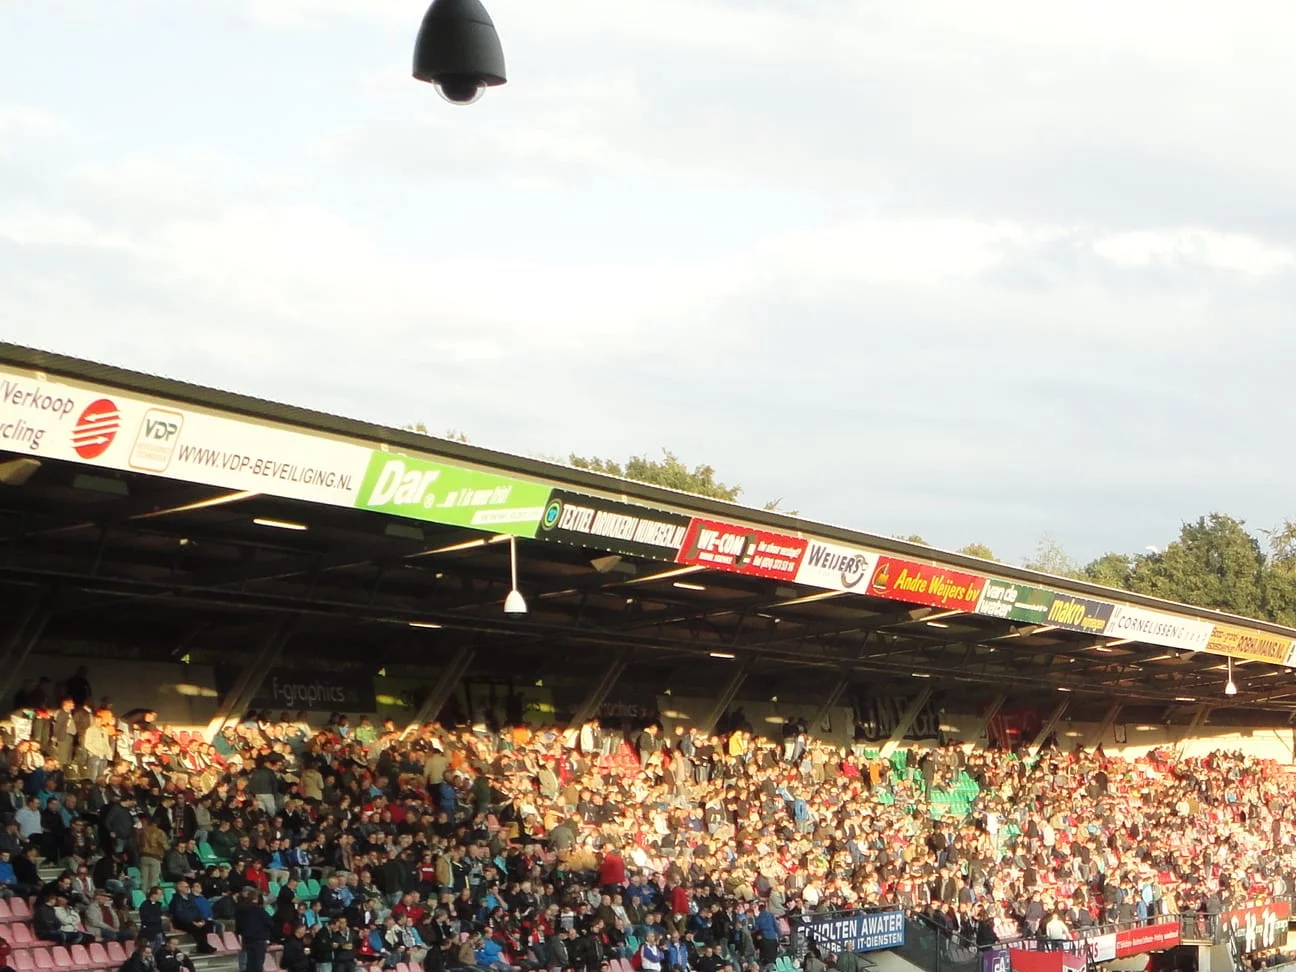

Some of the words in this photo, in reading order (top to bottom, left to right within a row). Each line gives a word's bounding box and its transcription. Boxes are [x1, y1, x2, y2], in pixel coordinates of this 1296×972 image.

[145, 418, 178, 442] VDP
[893, 567, 928, 593] Andre
[928, 576, 965, 602] Weijers
[966, 582, 980, 602] bv
[1047, 598, 1085, 625] makro
[1117, 615, 1178, 638] CORNELISSEN
[861, 913, 903, 937] AWATER
[857, 931, 903, 950] IT-DIENSTEN
